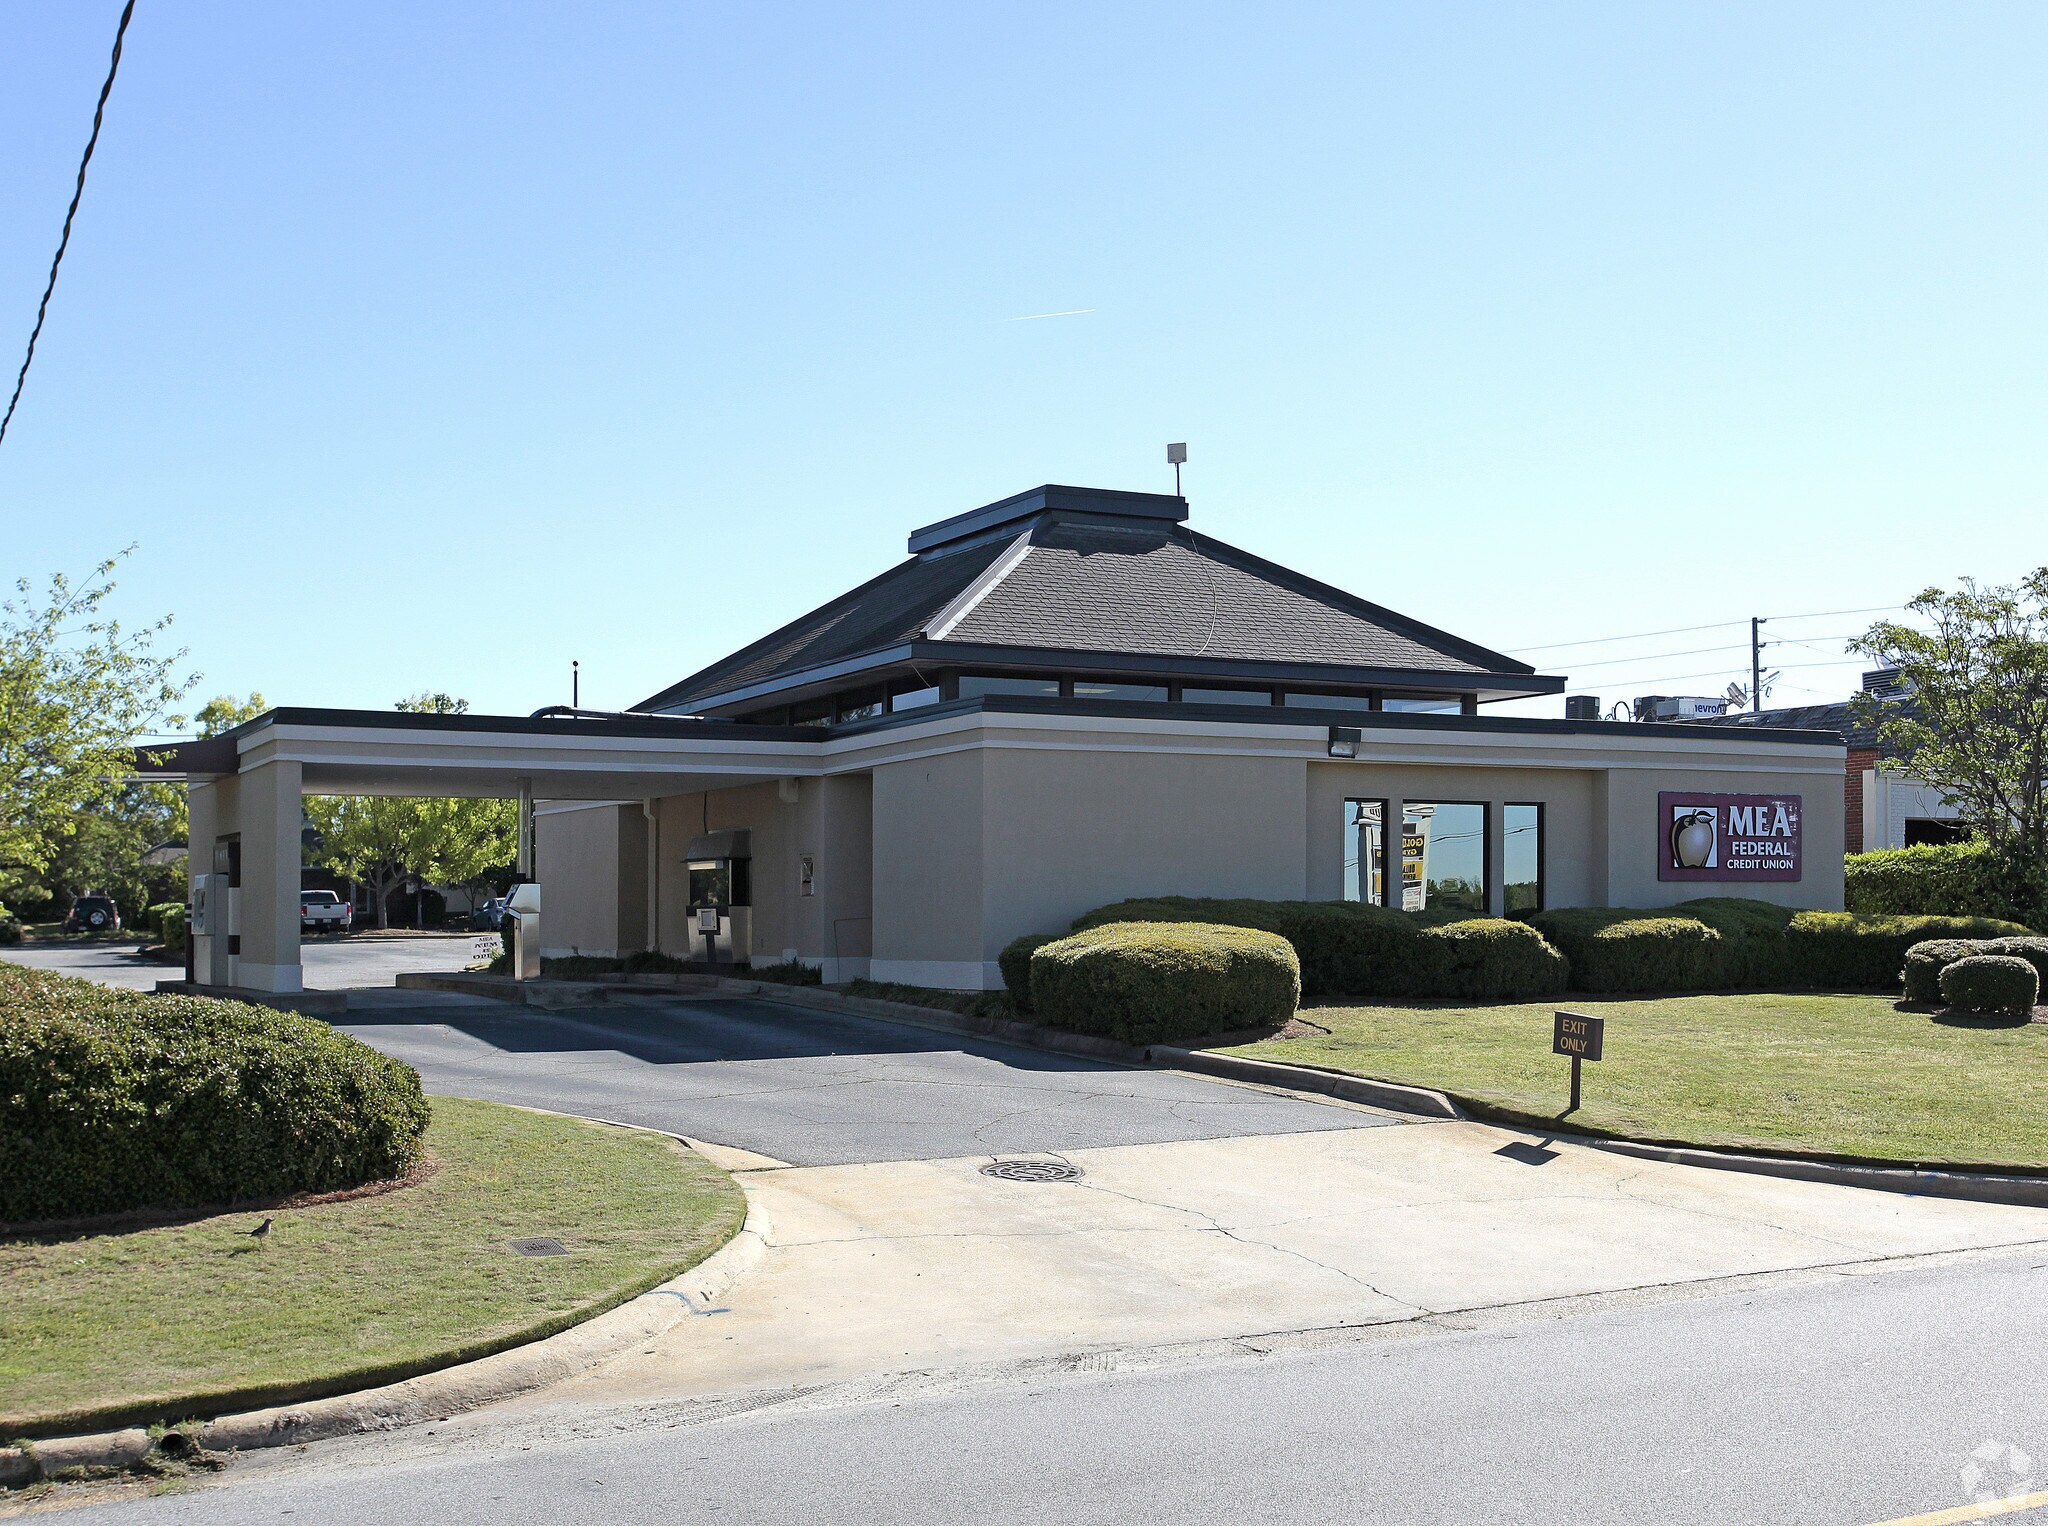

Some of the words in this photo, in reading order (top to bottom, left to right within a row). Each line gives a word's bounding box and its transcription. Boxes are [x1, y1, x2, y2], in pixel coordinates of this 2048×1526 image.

[1727, 805, 1793, 837] MEA
[1732, 841, 1792, 856] FEDERAL
[1726, 859, 1760, 869] CREDIT
[1762, 859, 1794, 869] UNION
[1562, 1019, 1587, 1035] EXIT
[1560, 1036, 1587, 1053] ONLY
